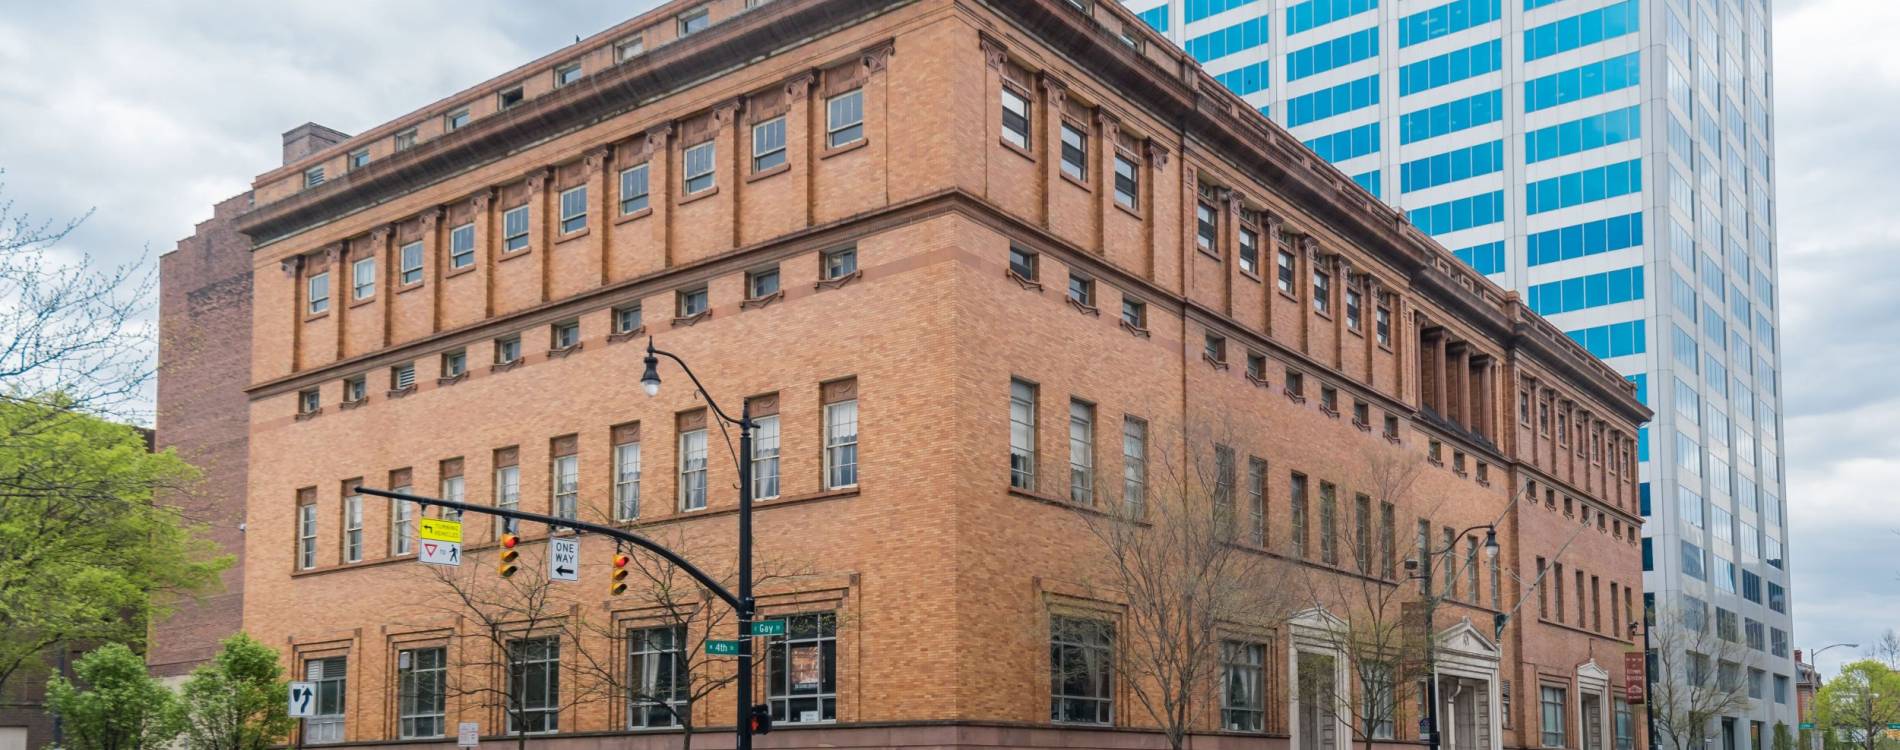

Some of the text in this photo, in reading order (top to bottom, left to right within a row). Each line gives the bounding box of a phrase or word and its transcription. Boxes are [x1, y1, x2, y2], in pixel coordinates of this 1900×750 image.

[555, 542, 575, 553] ONE
[555, 553, 575, 563] WAY
[759, 623, 774, 634] Gay
[715, 643, 728, 652] 4th
